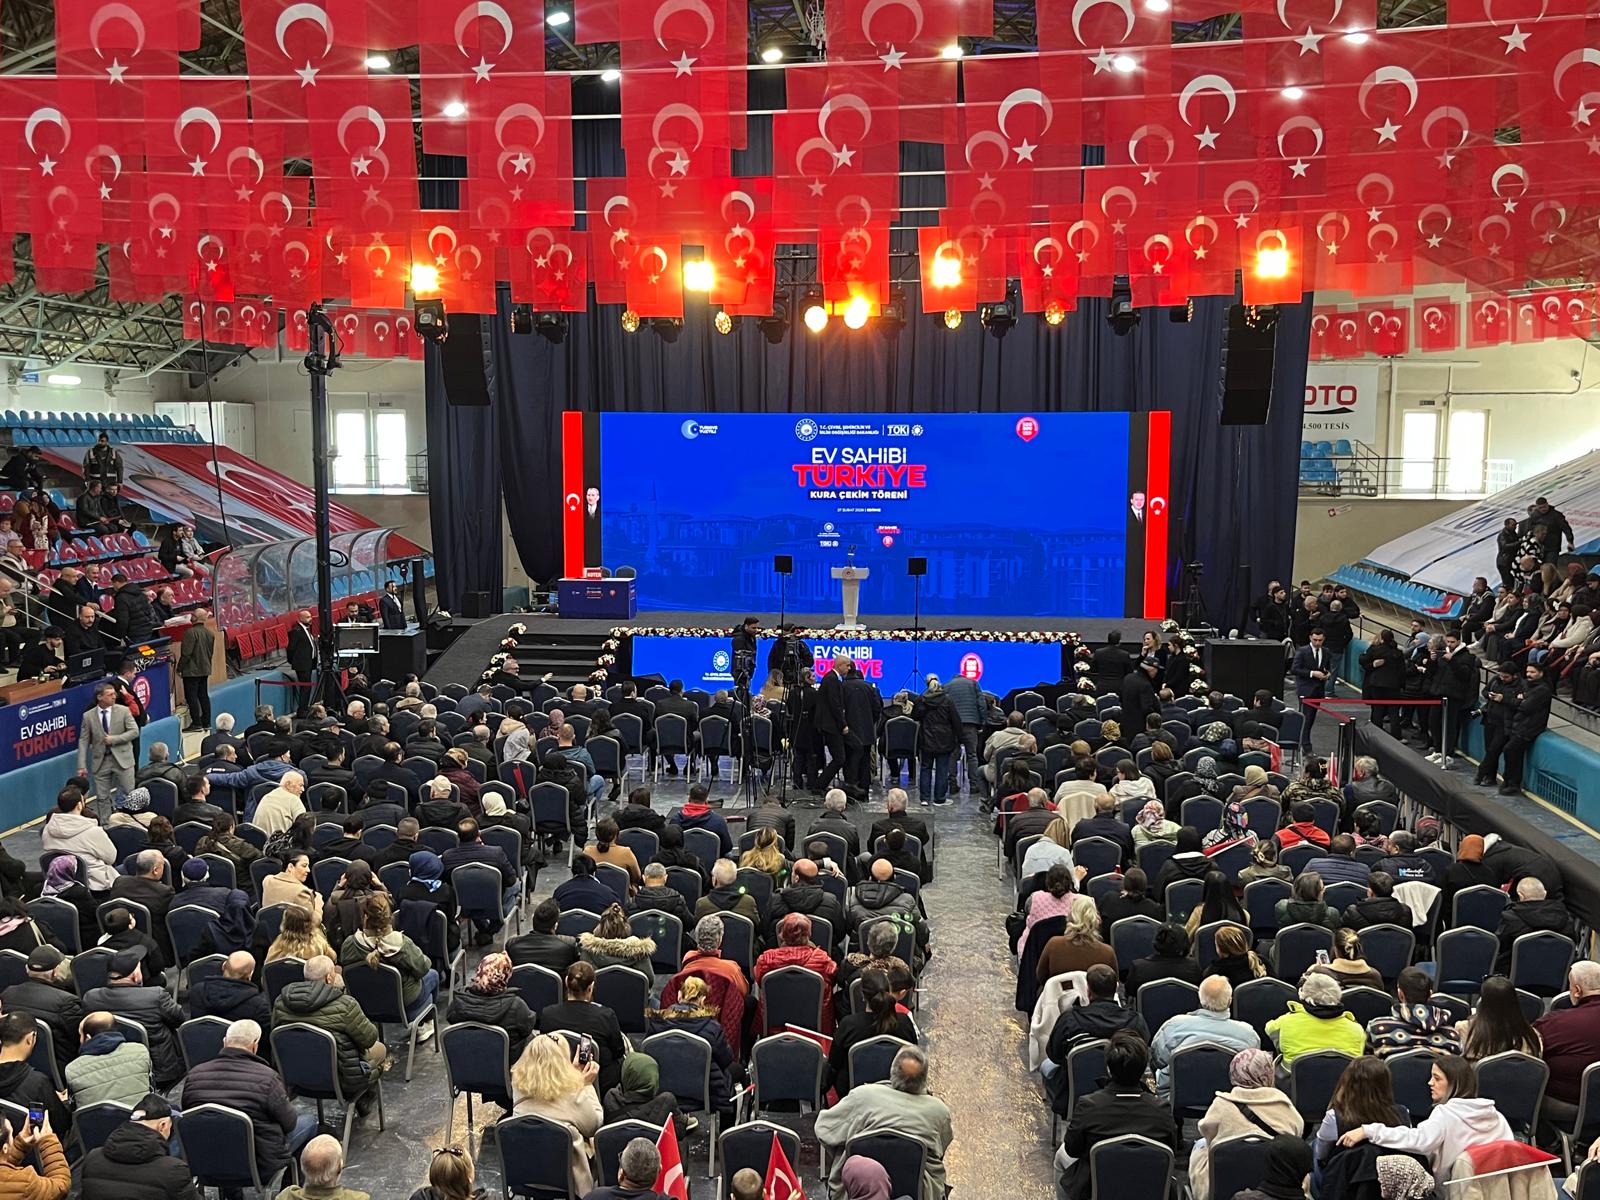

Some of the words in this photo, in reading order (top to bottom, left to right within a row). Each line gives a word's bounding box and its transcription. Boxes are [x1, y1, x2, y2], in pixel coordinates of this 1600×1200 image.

[1324, 421, 1350, 430] TESİS
[811, 447, 838, 464] EV
[841, 447, 907, 464] SAHİBİ
[792, 464, 927, 488] TÜRKİYE
[810, 490, 836, 499] KURA
[838, 489, 869, 501] ÇEKİM
[871, 489, 908, 499] TÖRENİ
[814, 646, 831, 658] EV
[20, 724, 34, 740] EV
[35, 714, 67, 735] SAHİBİ
[13, 725, 76, 761] TÜRKİYE
